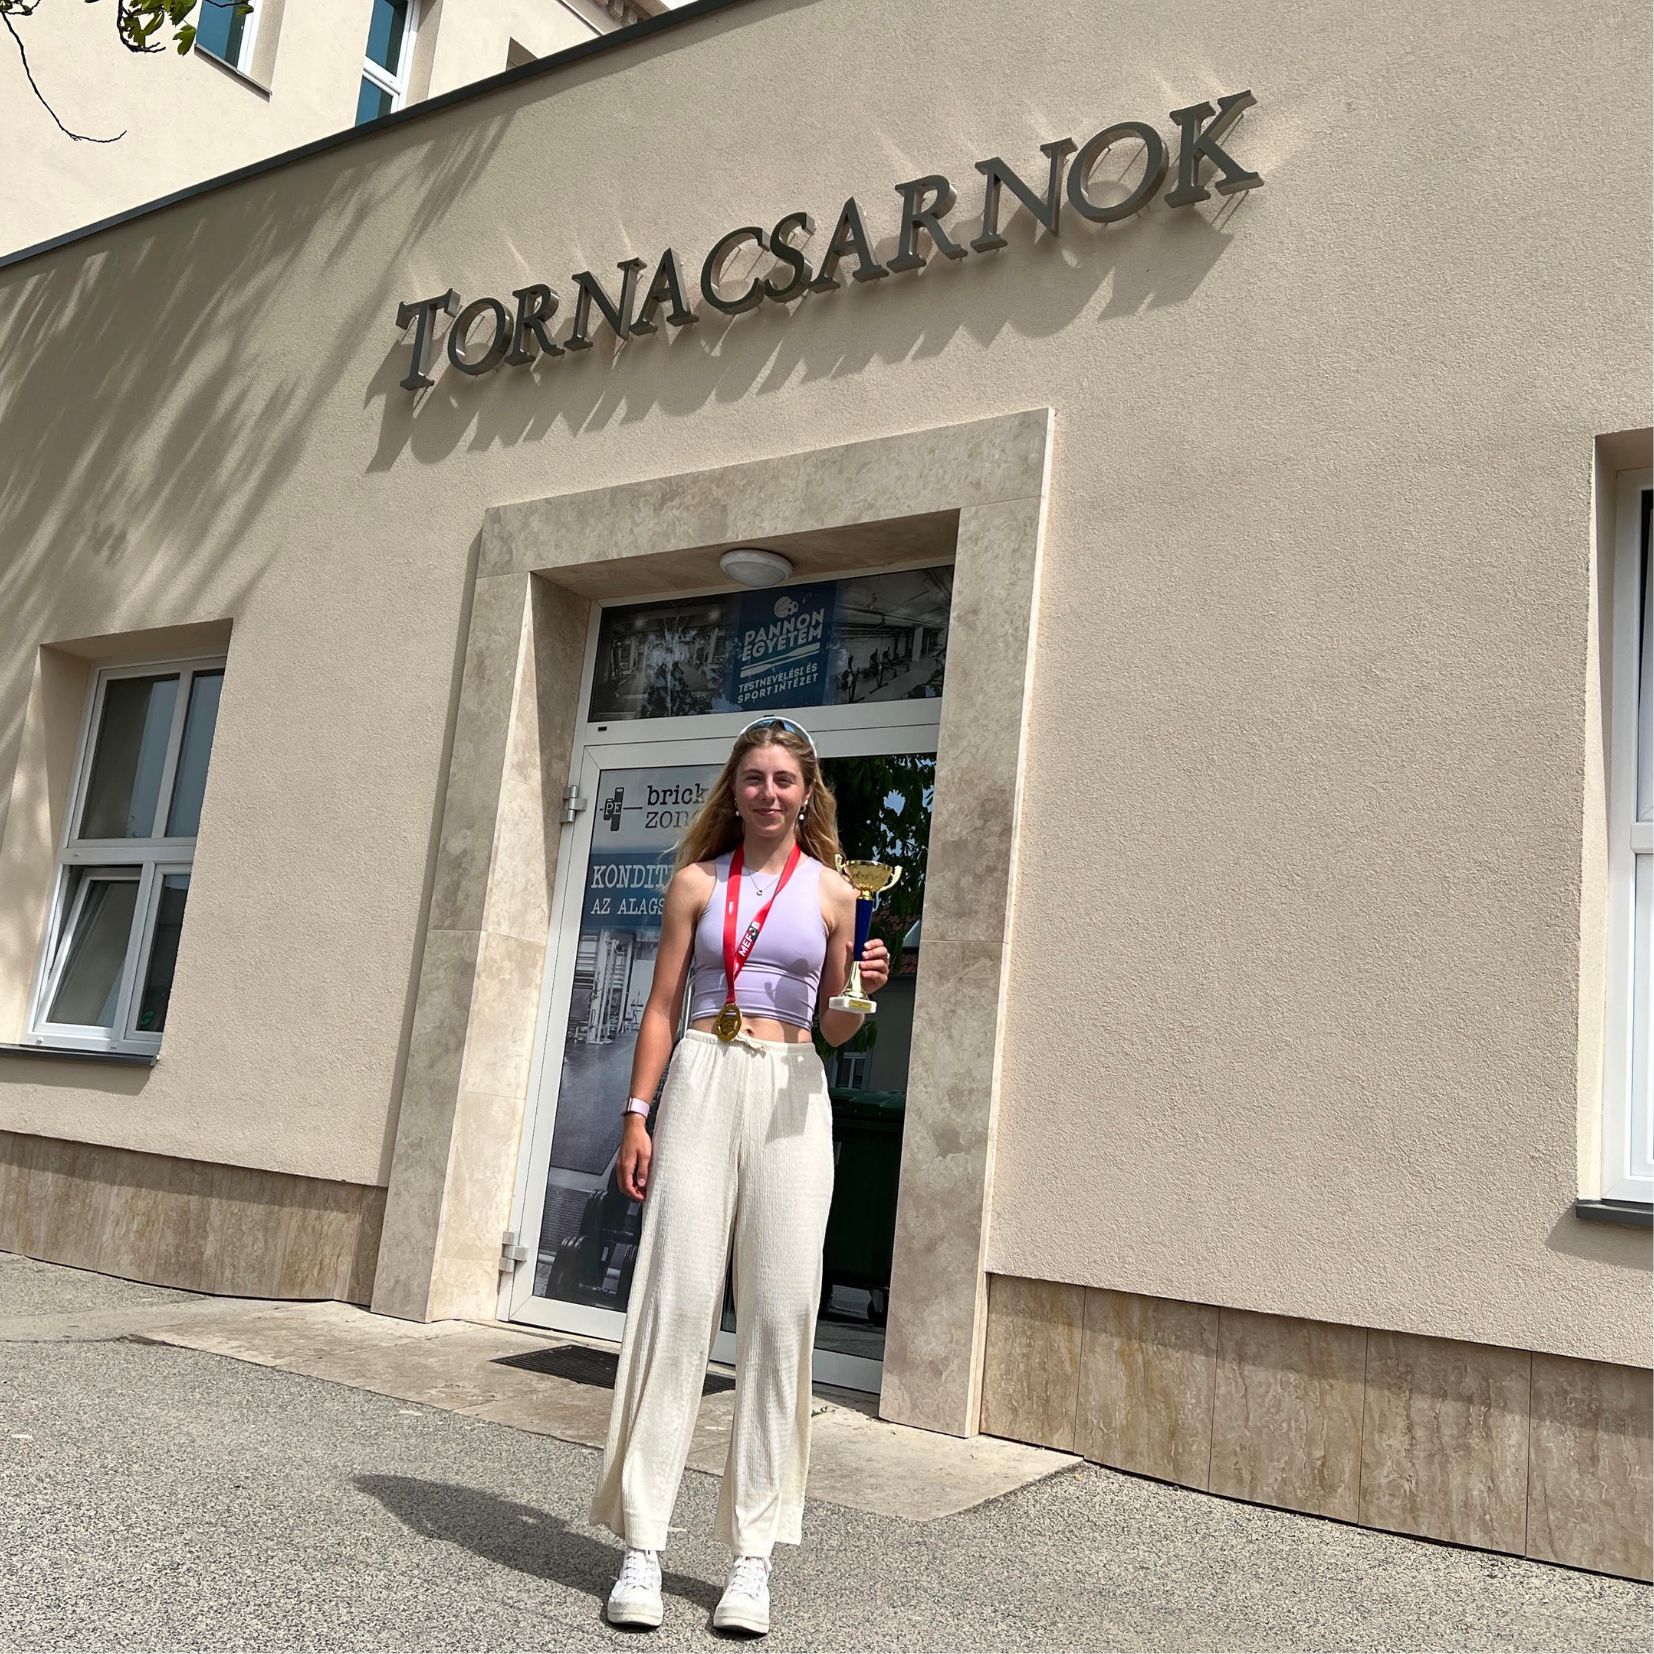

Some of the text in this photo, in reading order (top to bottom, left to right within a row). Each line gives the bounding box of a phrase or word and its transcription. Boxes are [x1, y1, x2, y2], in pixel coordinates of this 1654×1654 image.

[396, 89, 1265, 391] TORNACSARNOK
[744, 608, 825, 647] PANNON
[741, 624, 823, 661] EGYETEM
[737, 673, 819, 704] SPORT INTÉZET
[738, 661, 818, 693] TESTNEVELÉSI ÉS
[605, 801, 622, 816] PE
[646, 783, 709, 806] brick
[645, 808, 700, 829] zon
[591, 864, 675, 889] KONDIT
[591, 898, 611, 915] AZ
